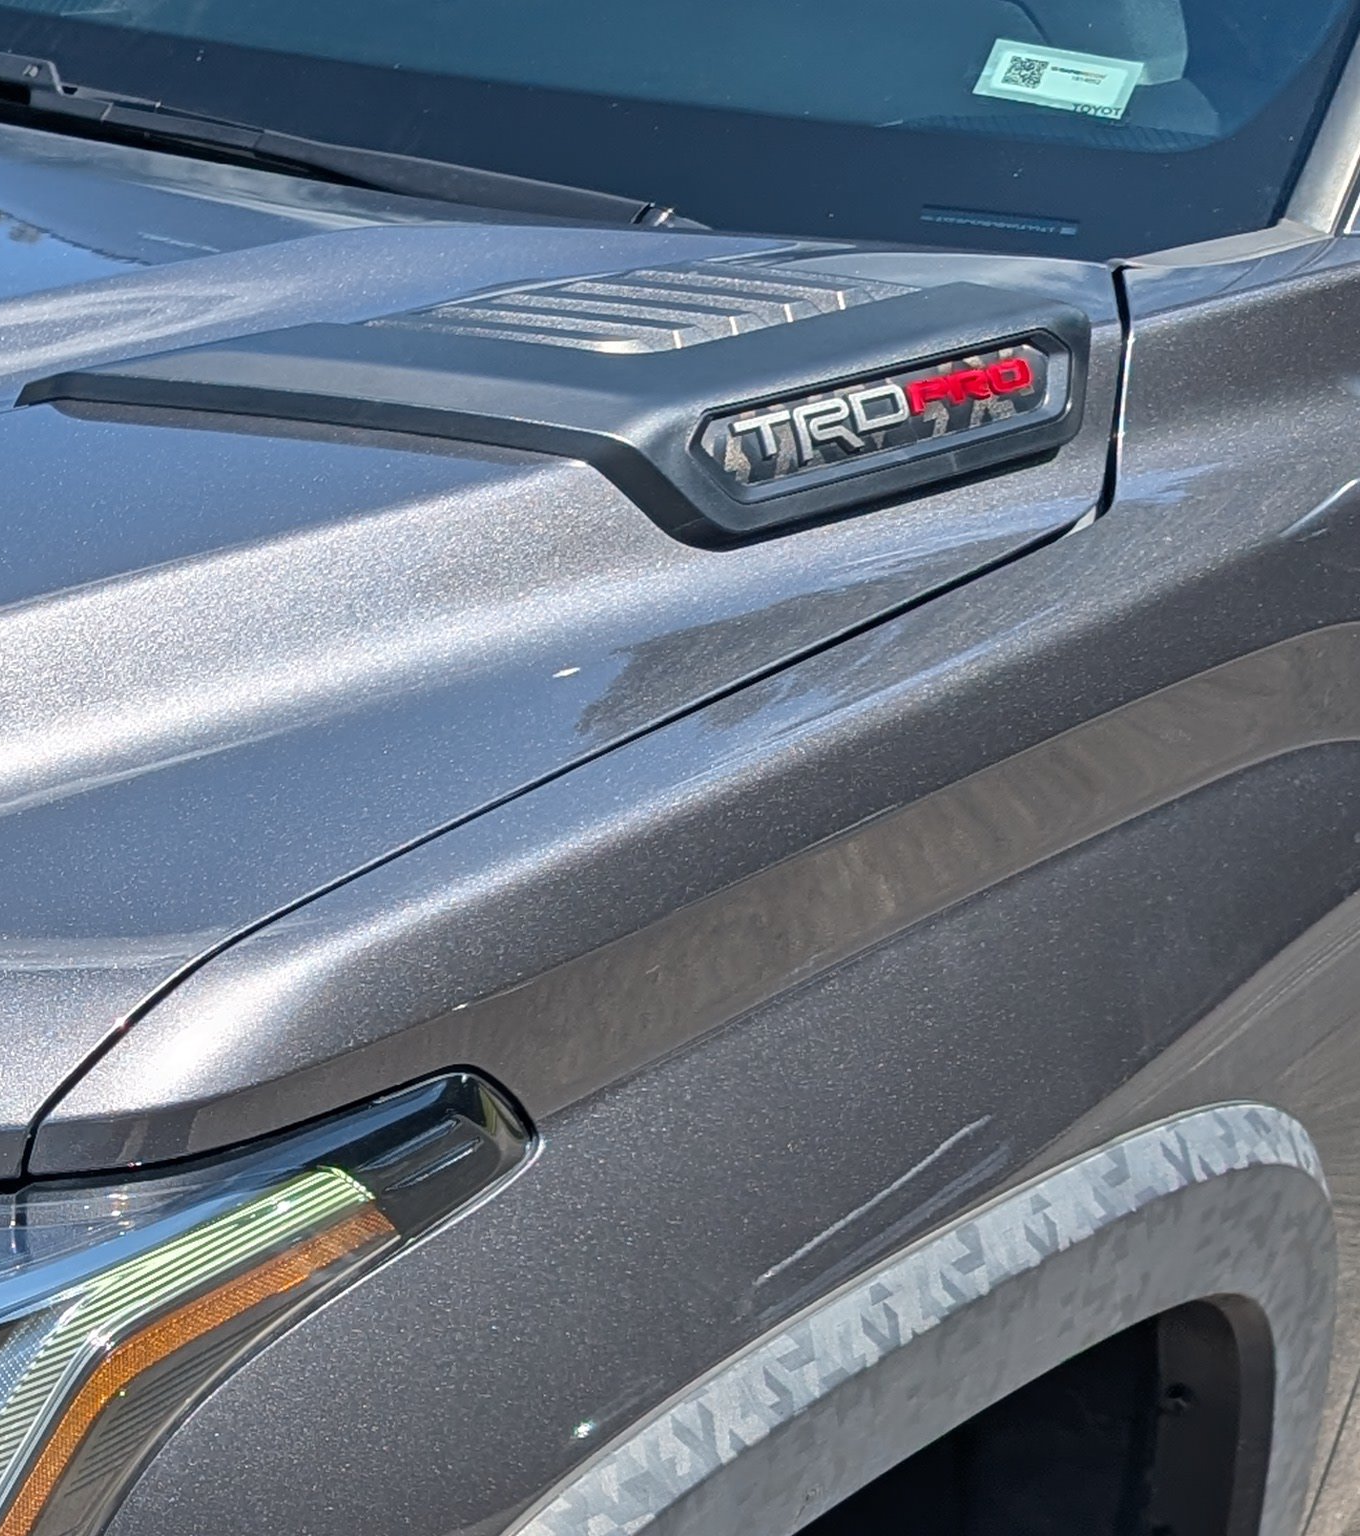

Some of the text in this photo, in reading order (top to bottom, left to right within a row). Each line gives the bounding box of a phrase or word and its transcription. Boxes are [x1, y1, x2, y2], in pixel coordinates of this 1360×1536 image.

[1071, 102, 1125, 117] TOYOT
[730, 357, 1035, 467] TRD PRO
